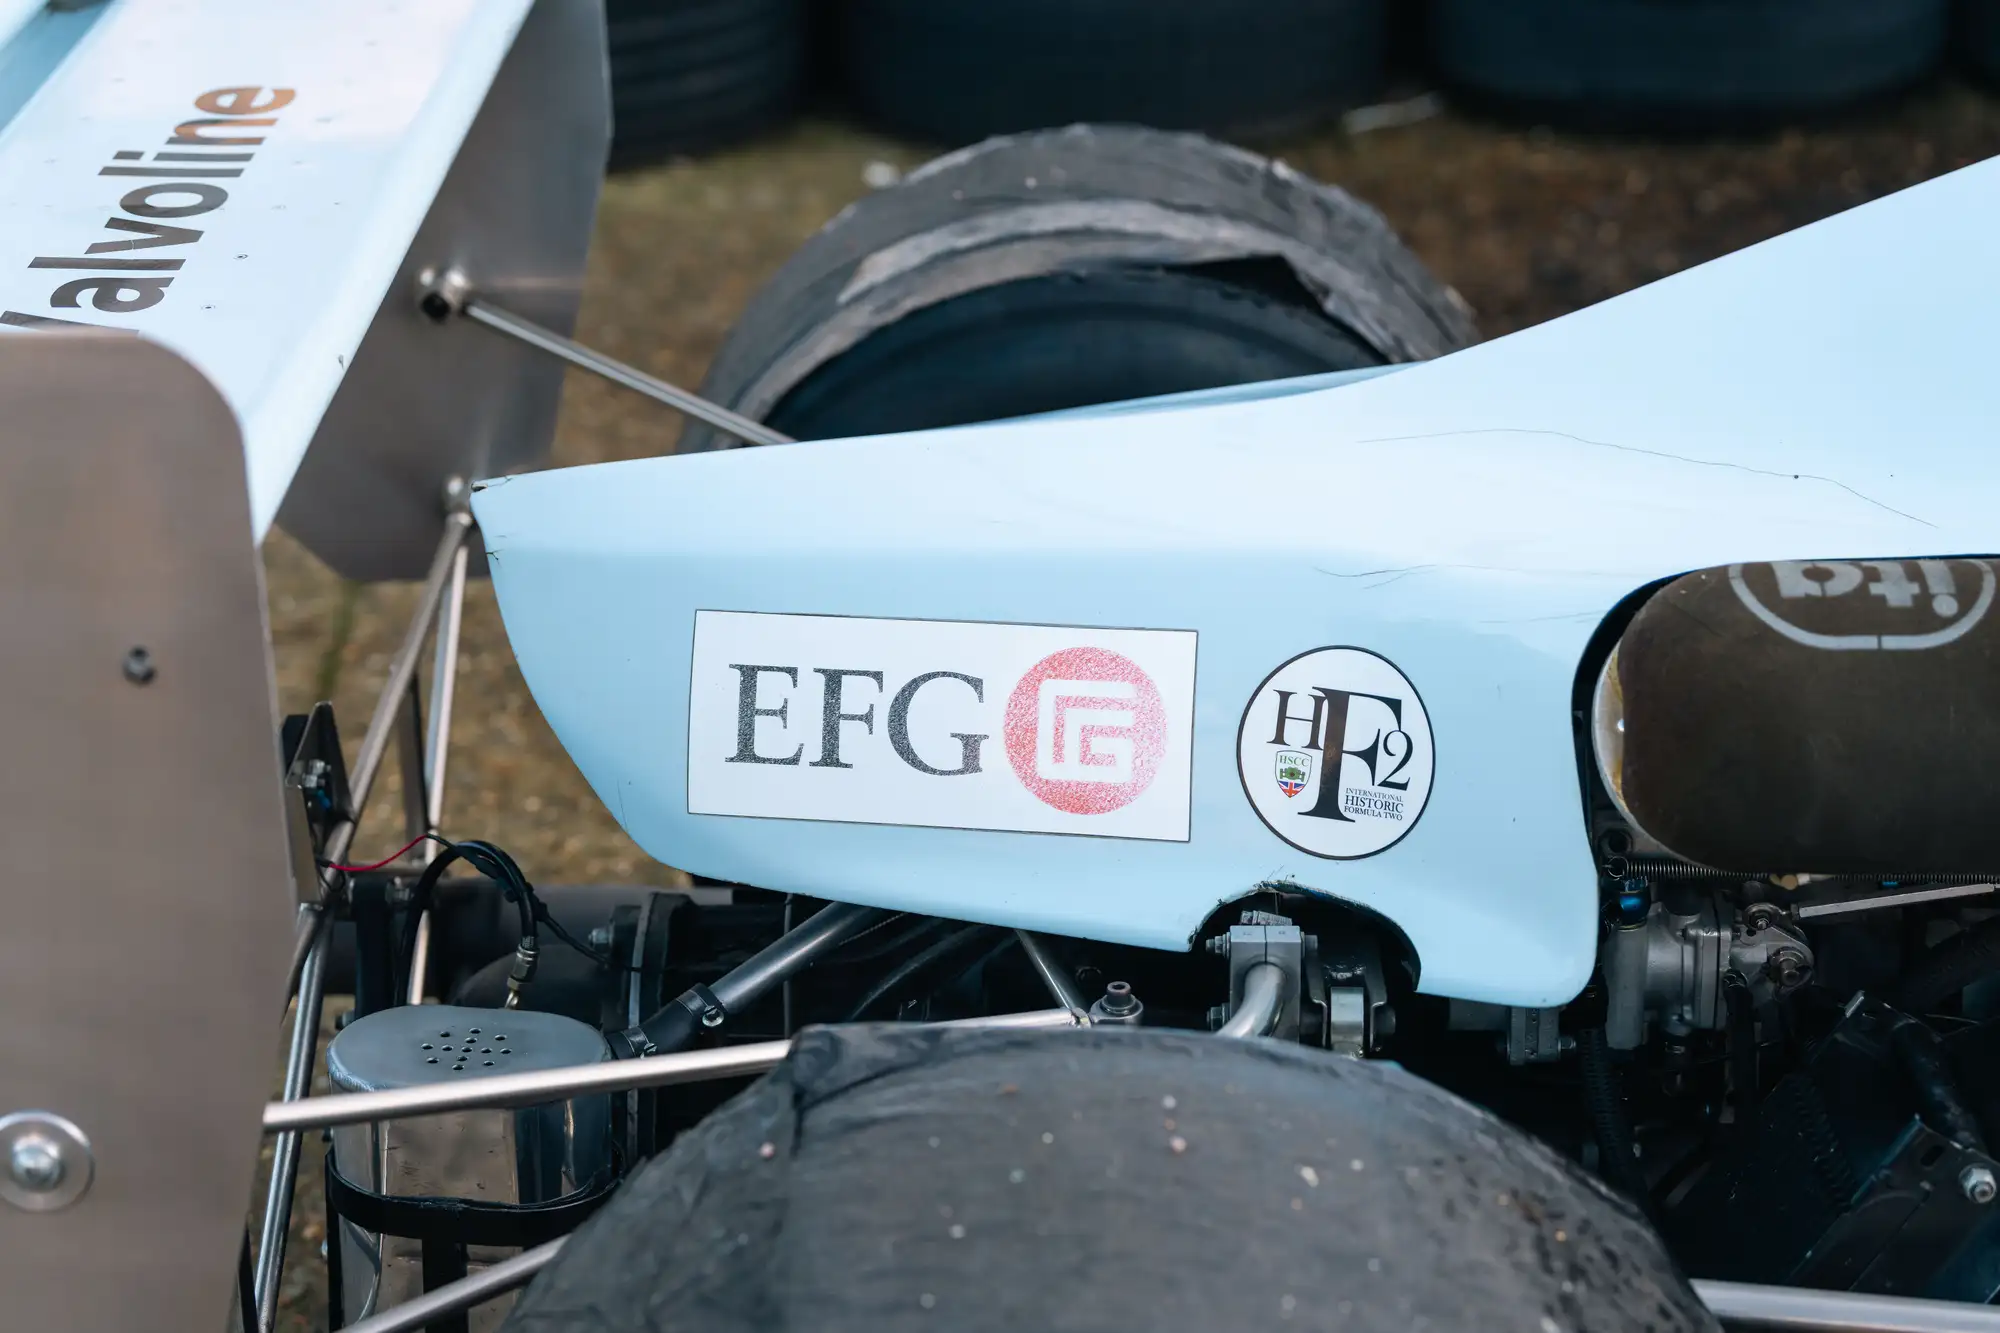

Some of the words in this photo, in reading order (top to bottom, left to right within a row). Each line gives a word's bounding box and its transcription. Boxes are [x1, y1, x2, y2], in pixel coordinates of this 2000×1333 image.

[724, 663, 990, 777] EFG
[1279, 754, 1310, 767] HSCC
[1345, 787, 1404, 802] INTERNATIONAL
[1345, 794, 1404, 814] HISTORIC
[1344, 805, 1382, 818] FORMULA
[1383, 811, 1403, 821] TWO
